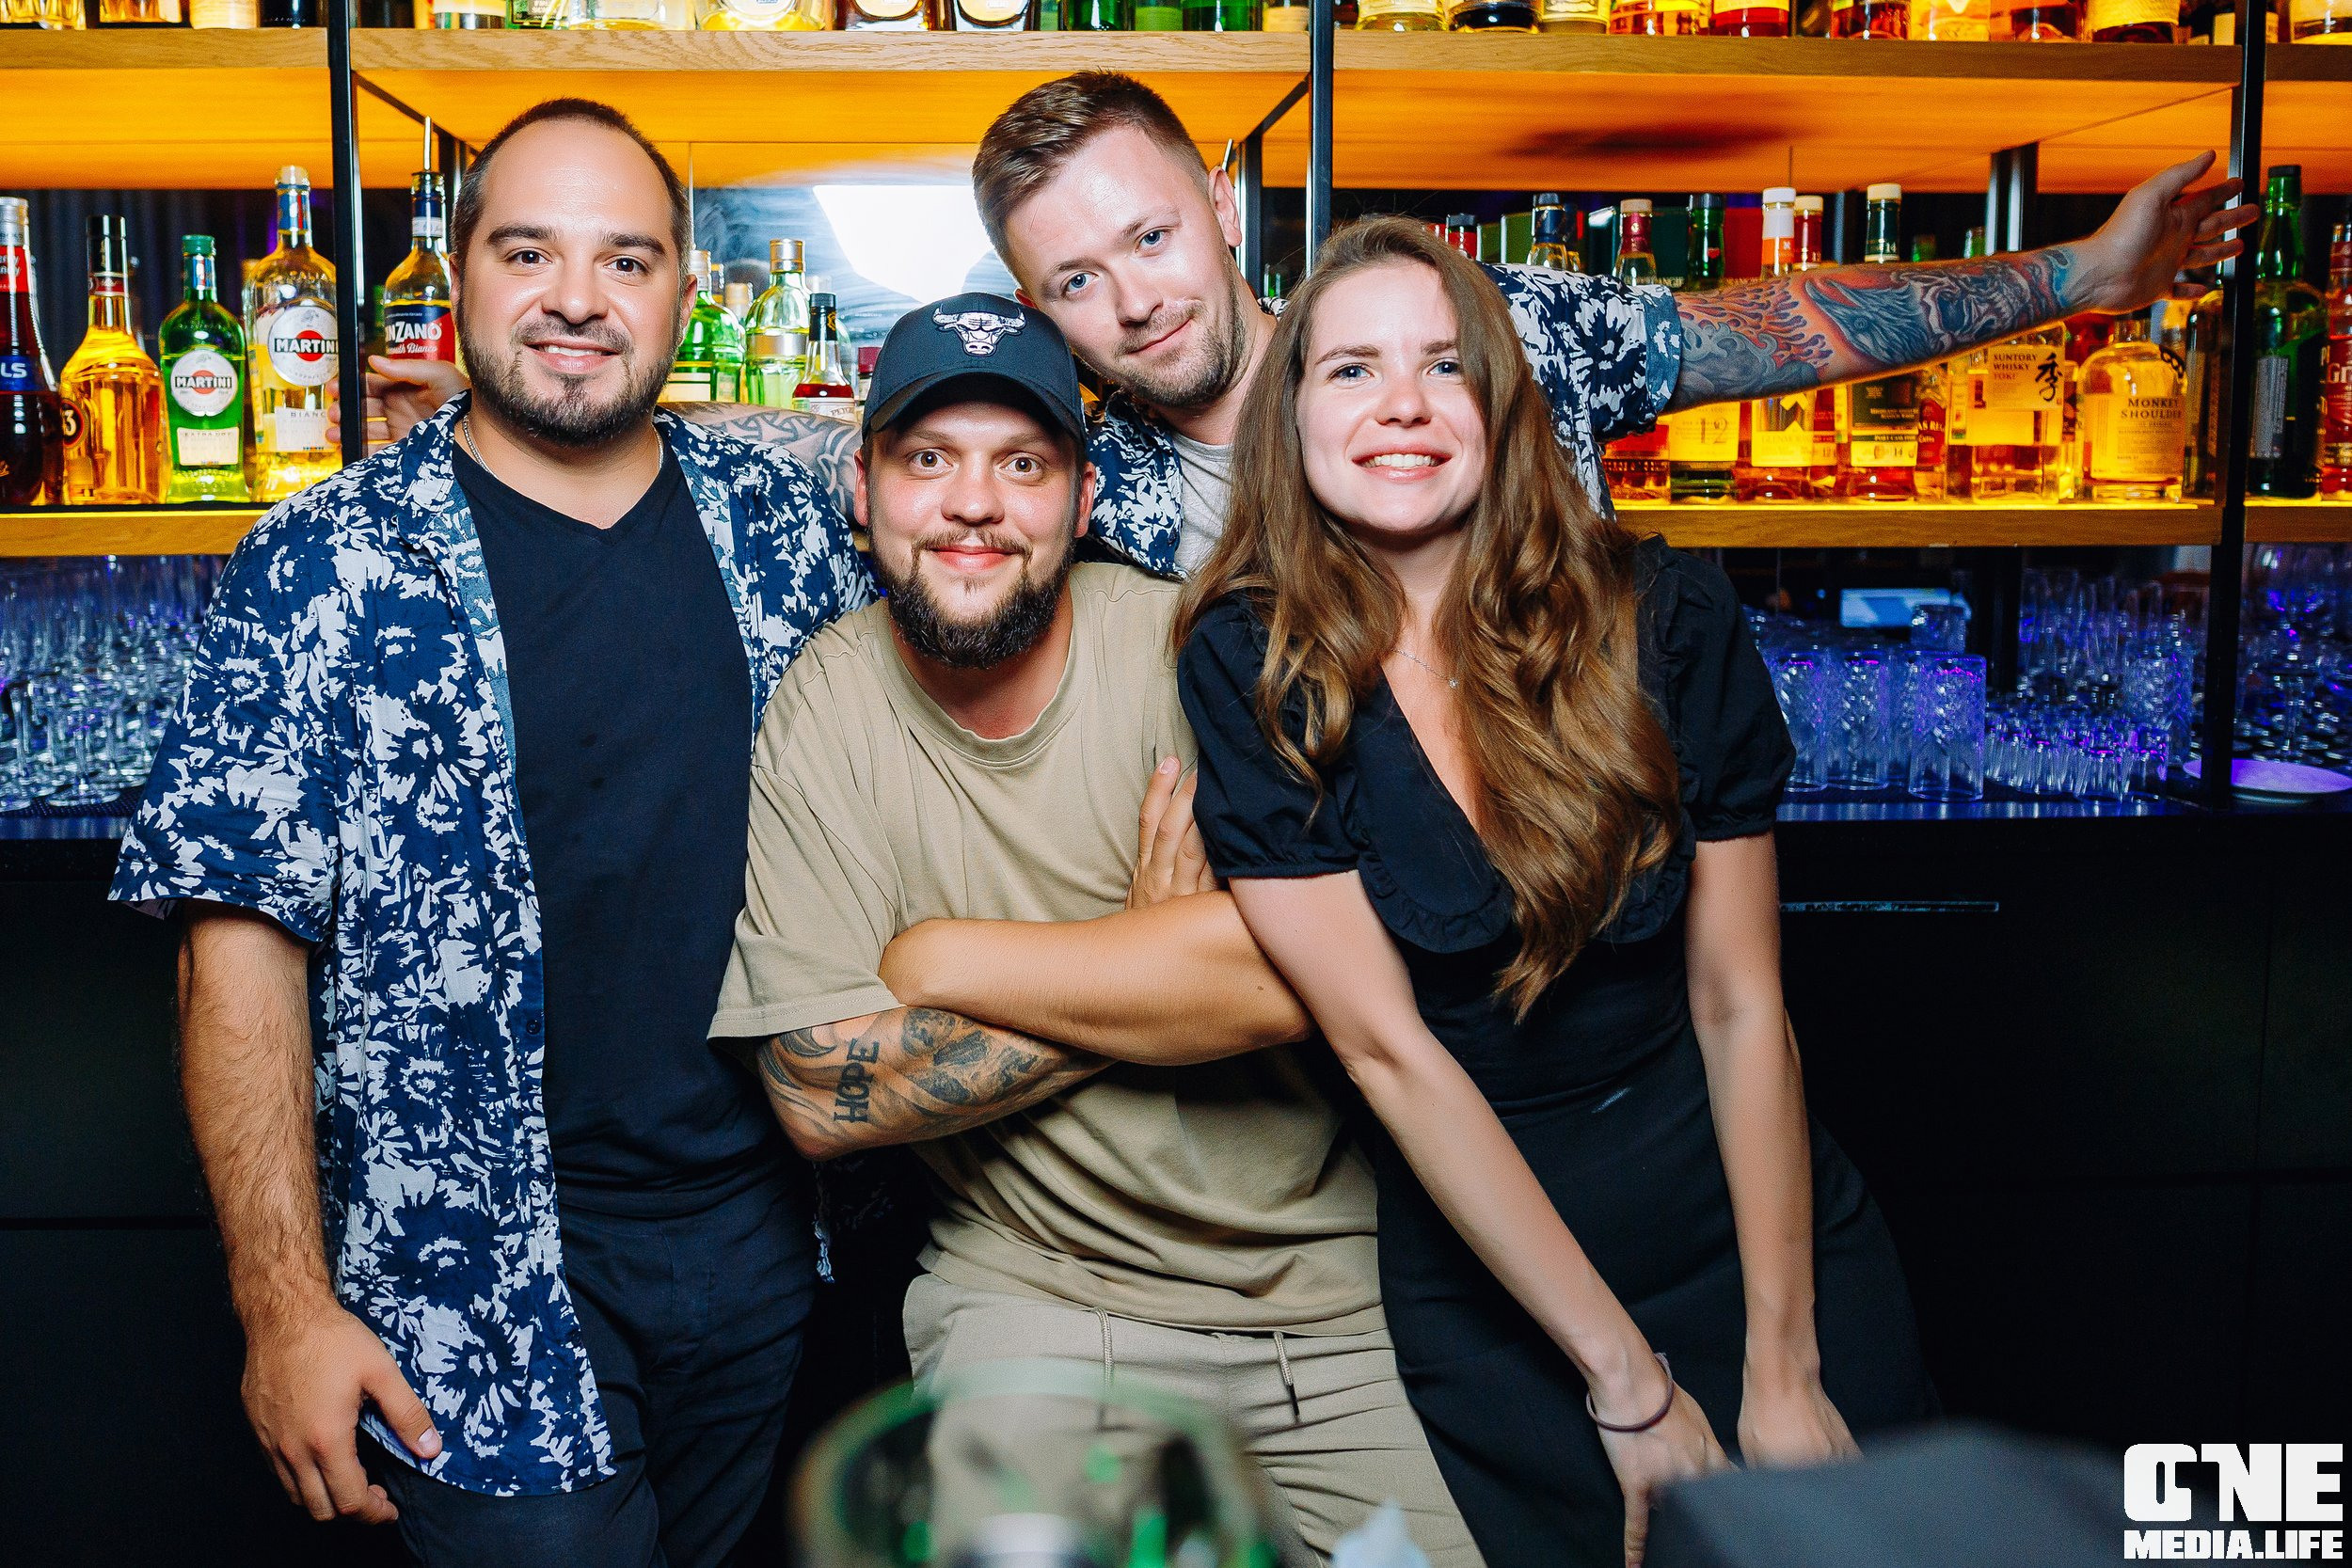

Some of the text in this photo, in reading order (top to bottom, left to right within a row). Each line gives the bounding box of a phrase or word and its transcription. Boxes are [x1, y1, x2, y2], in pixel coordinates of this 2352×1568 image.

[384, 321, 442, 342] INZANO
[1993, 353, 2037, 361] SUNTORY
[0, 362, 28, 378] LS
[175, 376, 232, 388] MARTINI
[833, 1037, 881, 1124] HOPE
